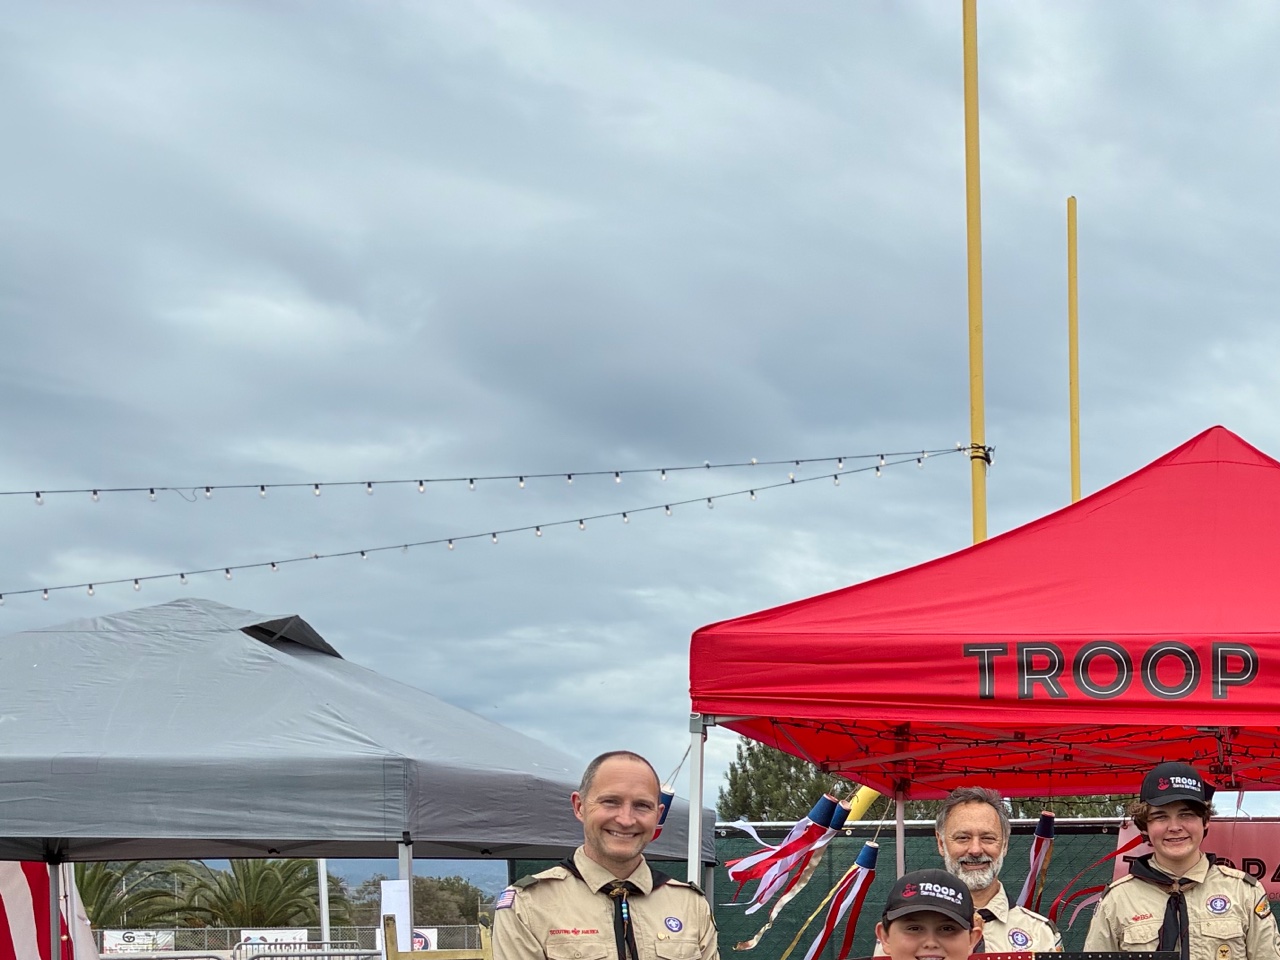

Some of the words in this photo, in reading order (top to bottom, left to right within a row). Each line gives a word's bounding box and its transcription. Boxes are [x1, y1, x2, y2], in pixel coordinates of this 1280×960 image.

[963, 640, 1260, 699] TROOP
[1169, 777, 1197, 786] TROOP
[919, 883, 957, 897] TROOP
[956, 892, 963, 900] 4
[1140, 913, 1153, 921] BSA
